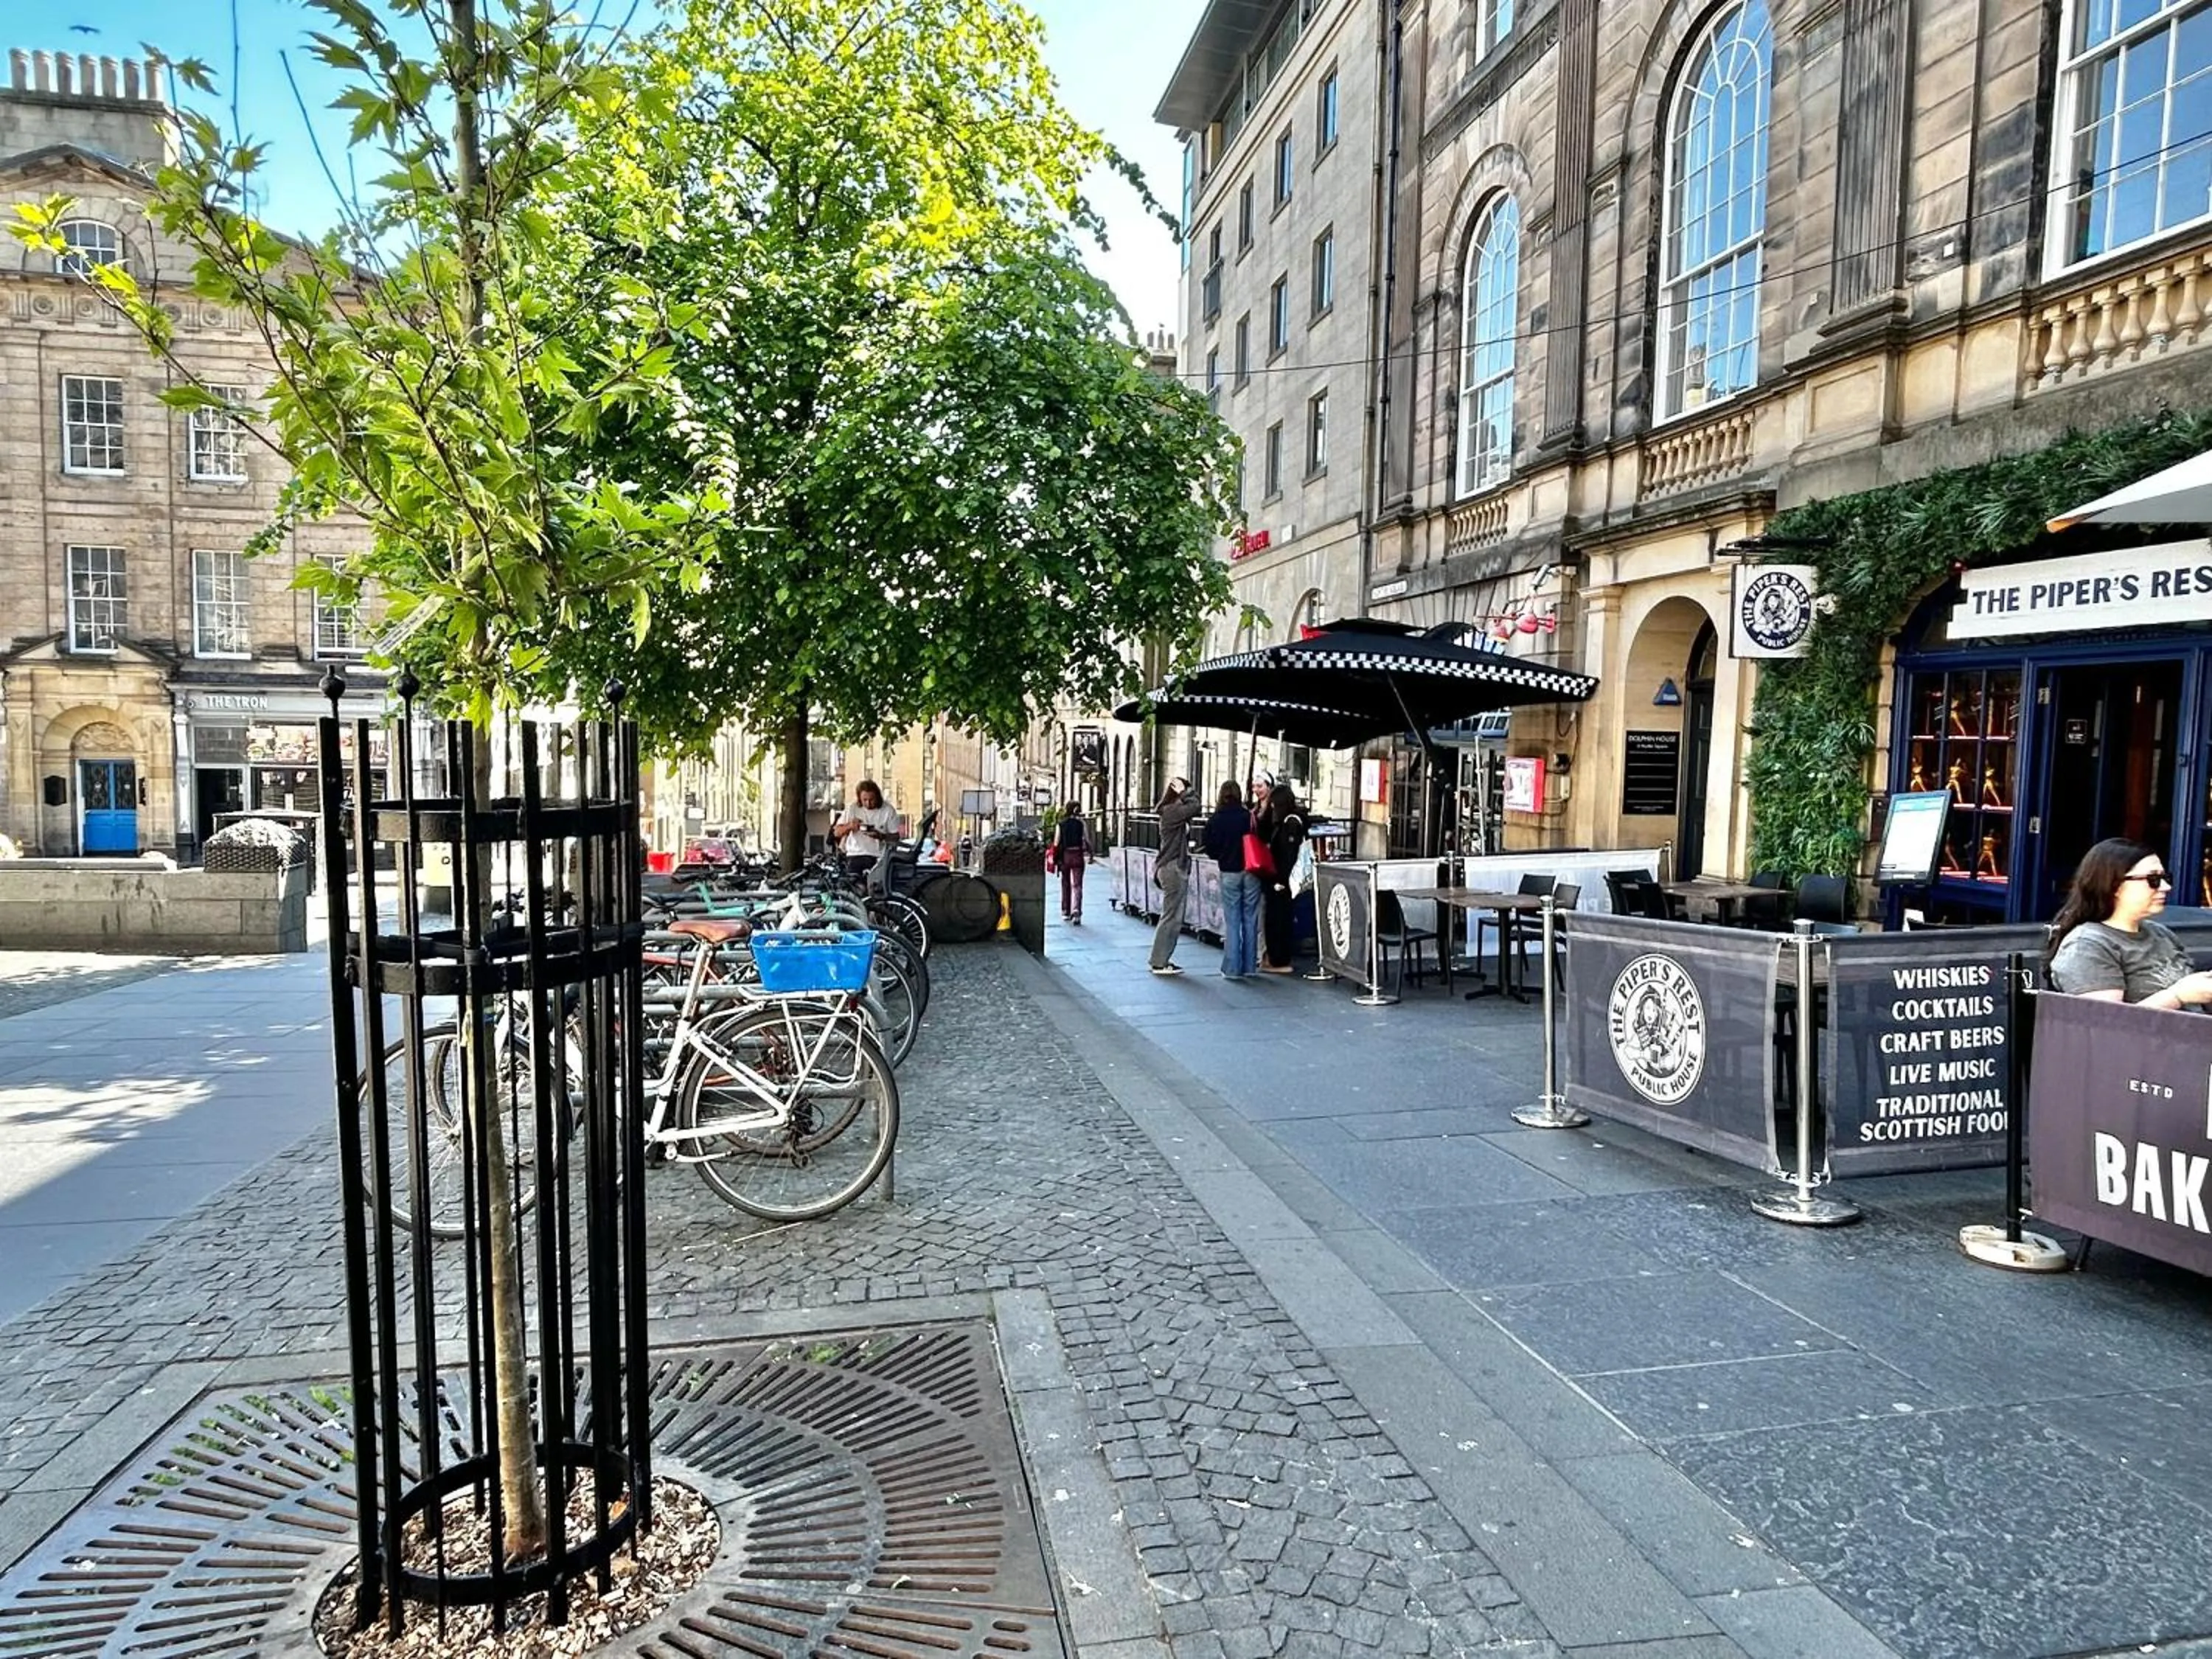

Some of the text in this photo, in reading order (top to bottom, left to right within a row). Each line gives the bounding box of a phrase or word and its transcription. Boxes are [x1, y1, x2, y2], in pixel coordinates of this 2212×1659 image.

[1744, 574, 1809, 627] THE PIPER'S REST
[1972, 587, 2020, 614] THE
[2030, 574, 2139, 610] PIPER'S
[207, 695, 268, 708] THE TRON
[1893, 966, 1991, 990] WHISKIES
[1613, 961, 1700, 1048] THE PIPER'S REST
[1892, 995, 1994, 1020] COCKTAILS
[1880, 1026, 2005, 1053] CRAFT BEERS
[1630, 1051, 1698, 1096] PUBLIC HOUSE
[1890, 1058, 1995, 1085] LIVE MUSIC
[1876, 1088, 2003, 1118] TRADITIONAL
[2129, 1079, 2173, 1099] ESTD
[1860, 1111, 2008, 1141] SCOTTISH FOO
